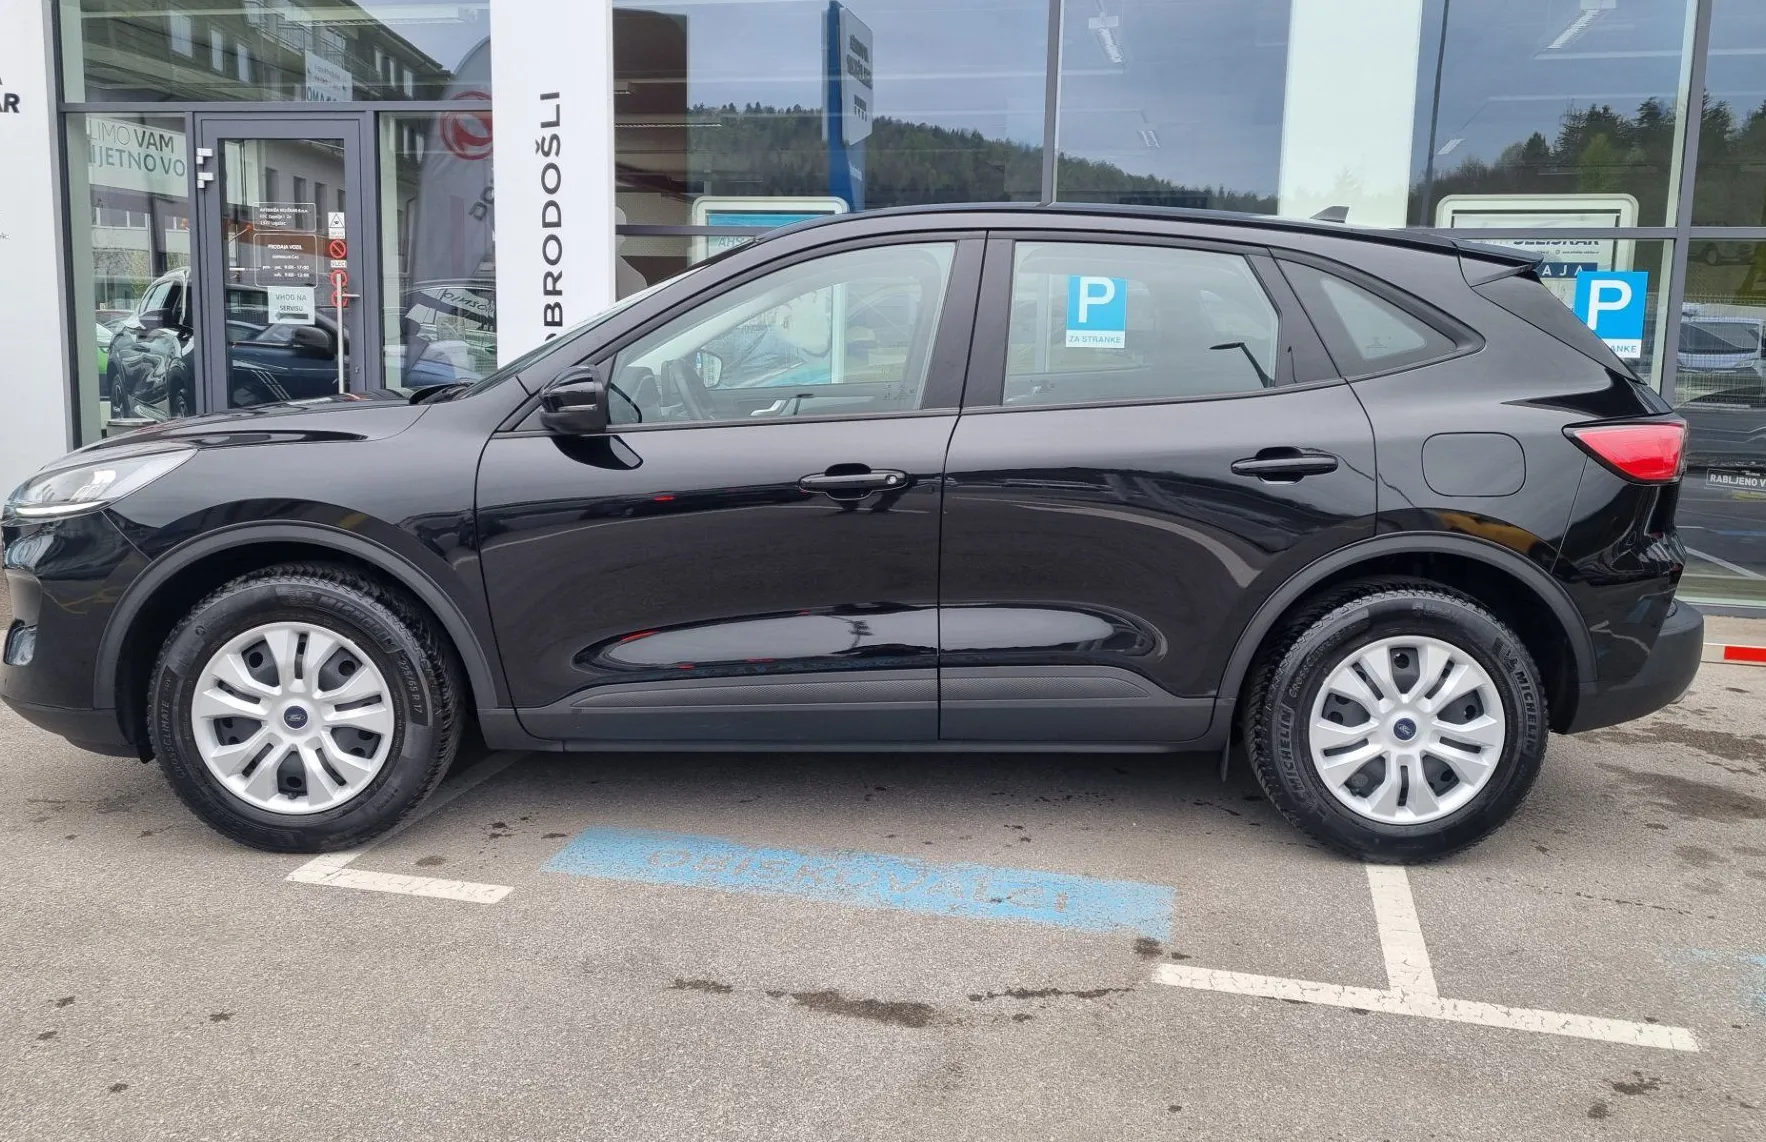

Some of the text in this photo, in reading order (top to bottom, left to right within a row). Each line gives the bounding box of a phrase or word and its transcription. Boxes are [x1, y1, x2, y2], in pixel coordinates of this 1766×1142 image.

[0, 92, 20, 114] R
[133, 128, 174, 154] VAM
[535, 91, 563, 342] BRODOŠLI
[1078, 276, 1116, 323] P
[1586, 279, 1633, 331] P
[1068, 335, 1122, 344] ZA STRANKE
[1709, 473, 1758, 488] RABLJENO
[1514, 671, 1538, 753] MICHELIN
[1278, 708, 1306, 792] MICHELIN
